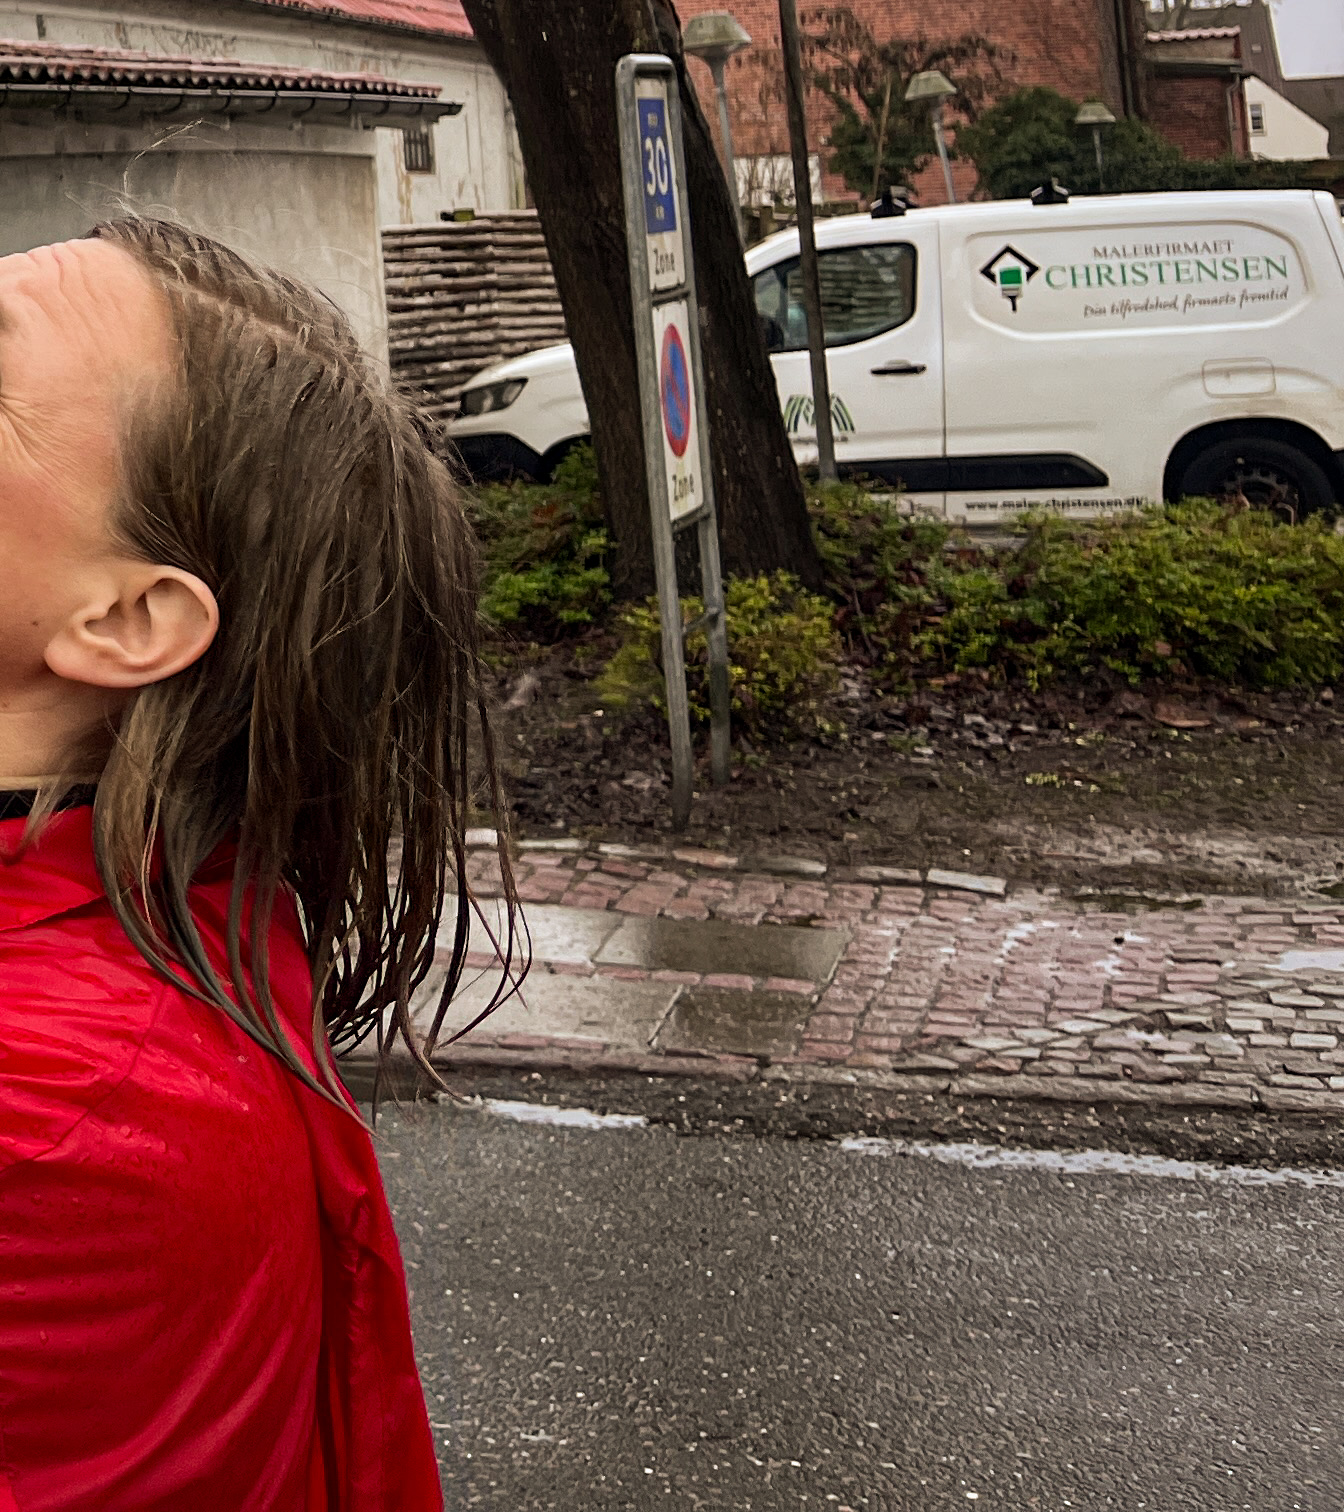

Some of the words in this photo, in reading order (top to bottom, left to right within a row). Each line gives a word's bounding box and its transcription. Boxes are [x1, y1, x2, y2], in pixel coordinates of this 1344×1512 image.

[645, 136, 669, 197] 30
[653, 247, 676, 275] Zone
[1093, 240, 1235, 260] MALERFIRMAET
[1045, 255, 1289, 290] CHRISTENSEN
